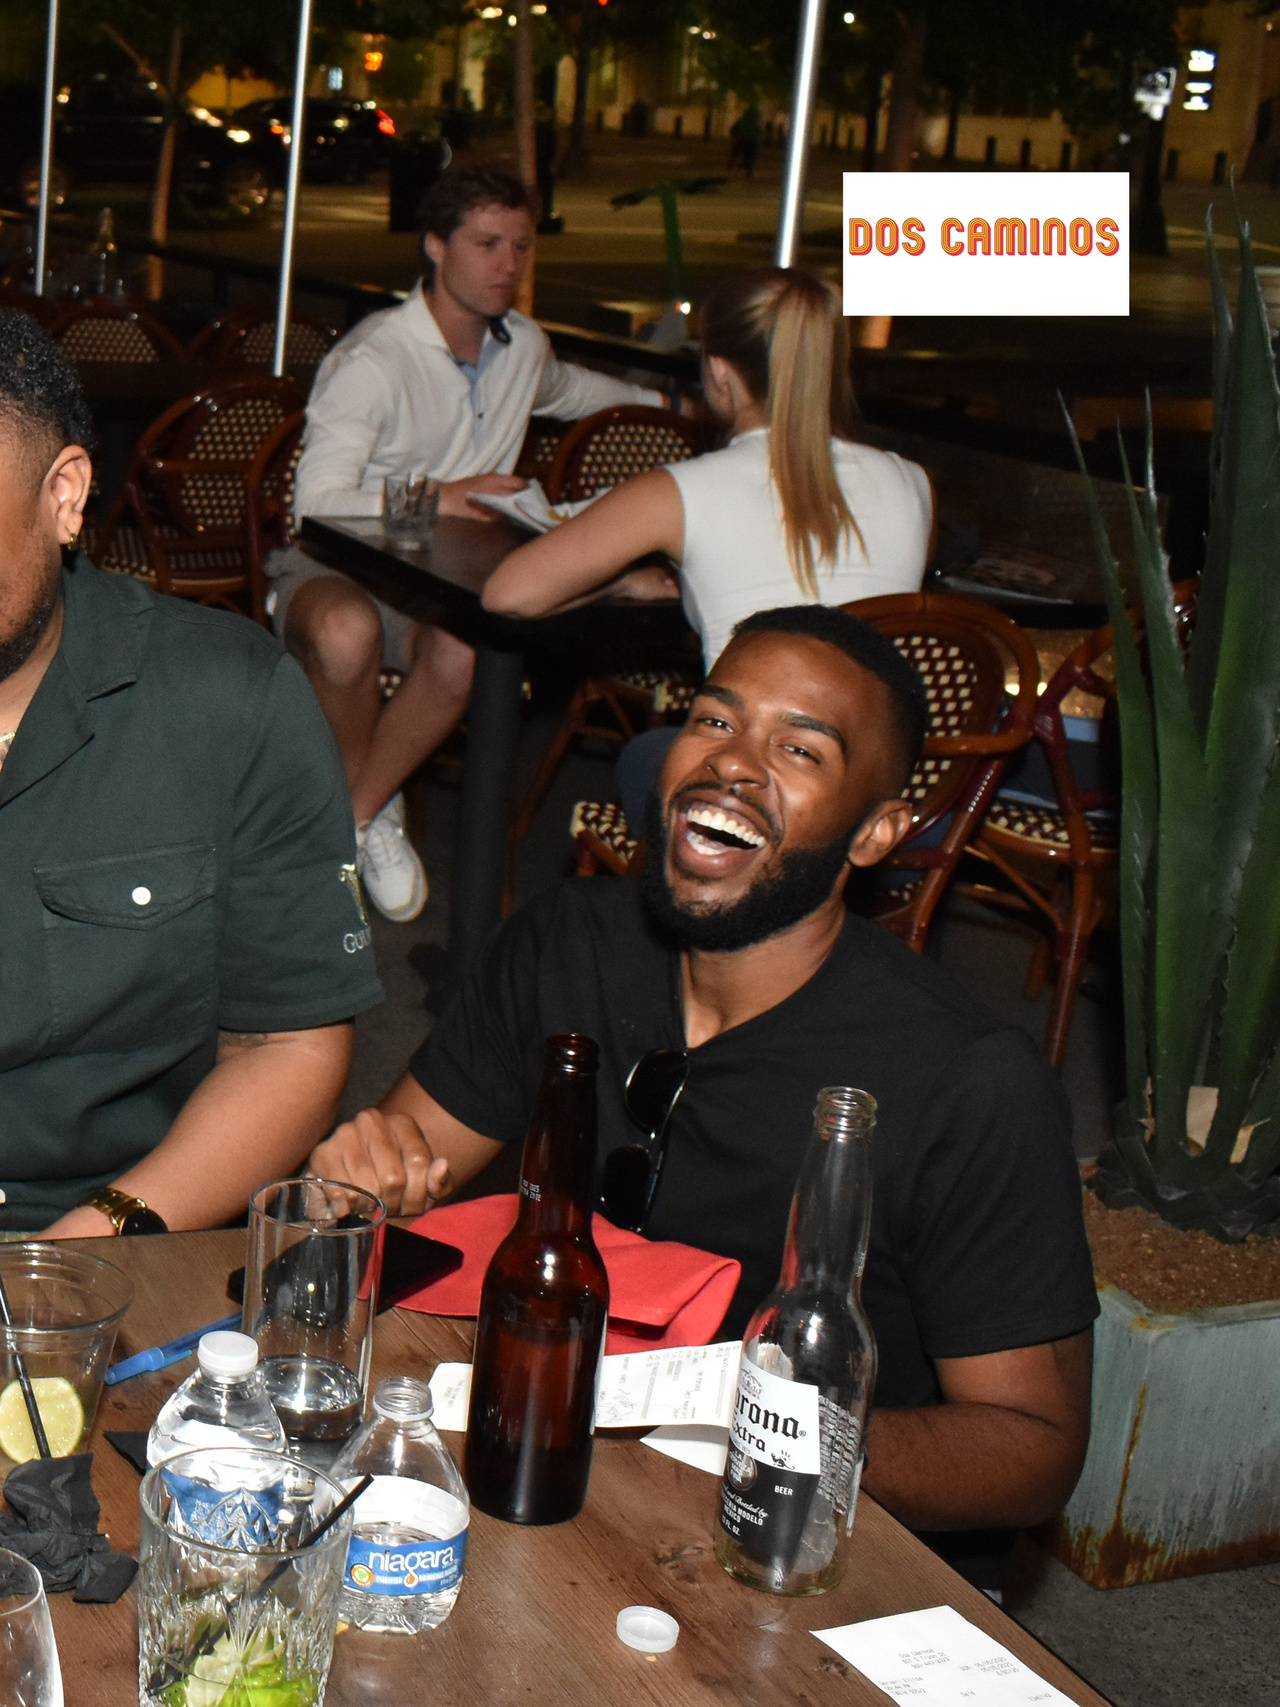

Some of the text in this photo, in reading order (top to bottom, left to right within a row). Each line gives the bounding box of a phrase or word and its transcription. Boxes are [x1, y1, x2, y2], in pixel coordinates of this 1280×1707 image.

[732, 1422, 766, 1452] xtra
[774, 1485, 794, 1496] BEER
[737, 1507, 764, 1526] MODELO
[369, 1546, 455, 1587] niagara
